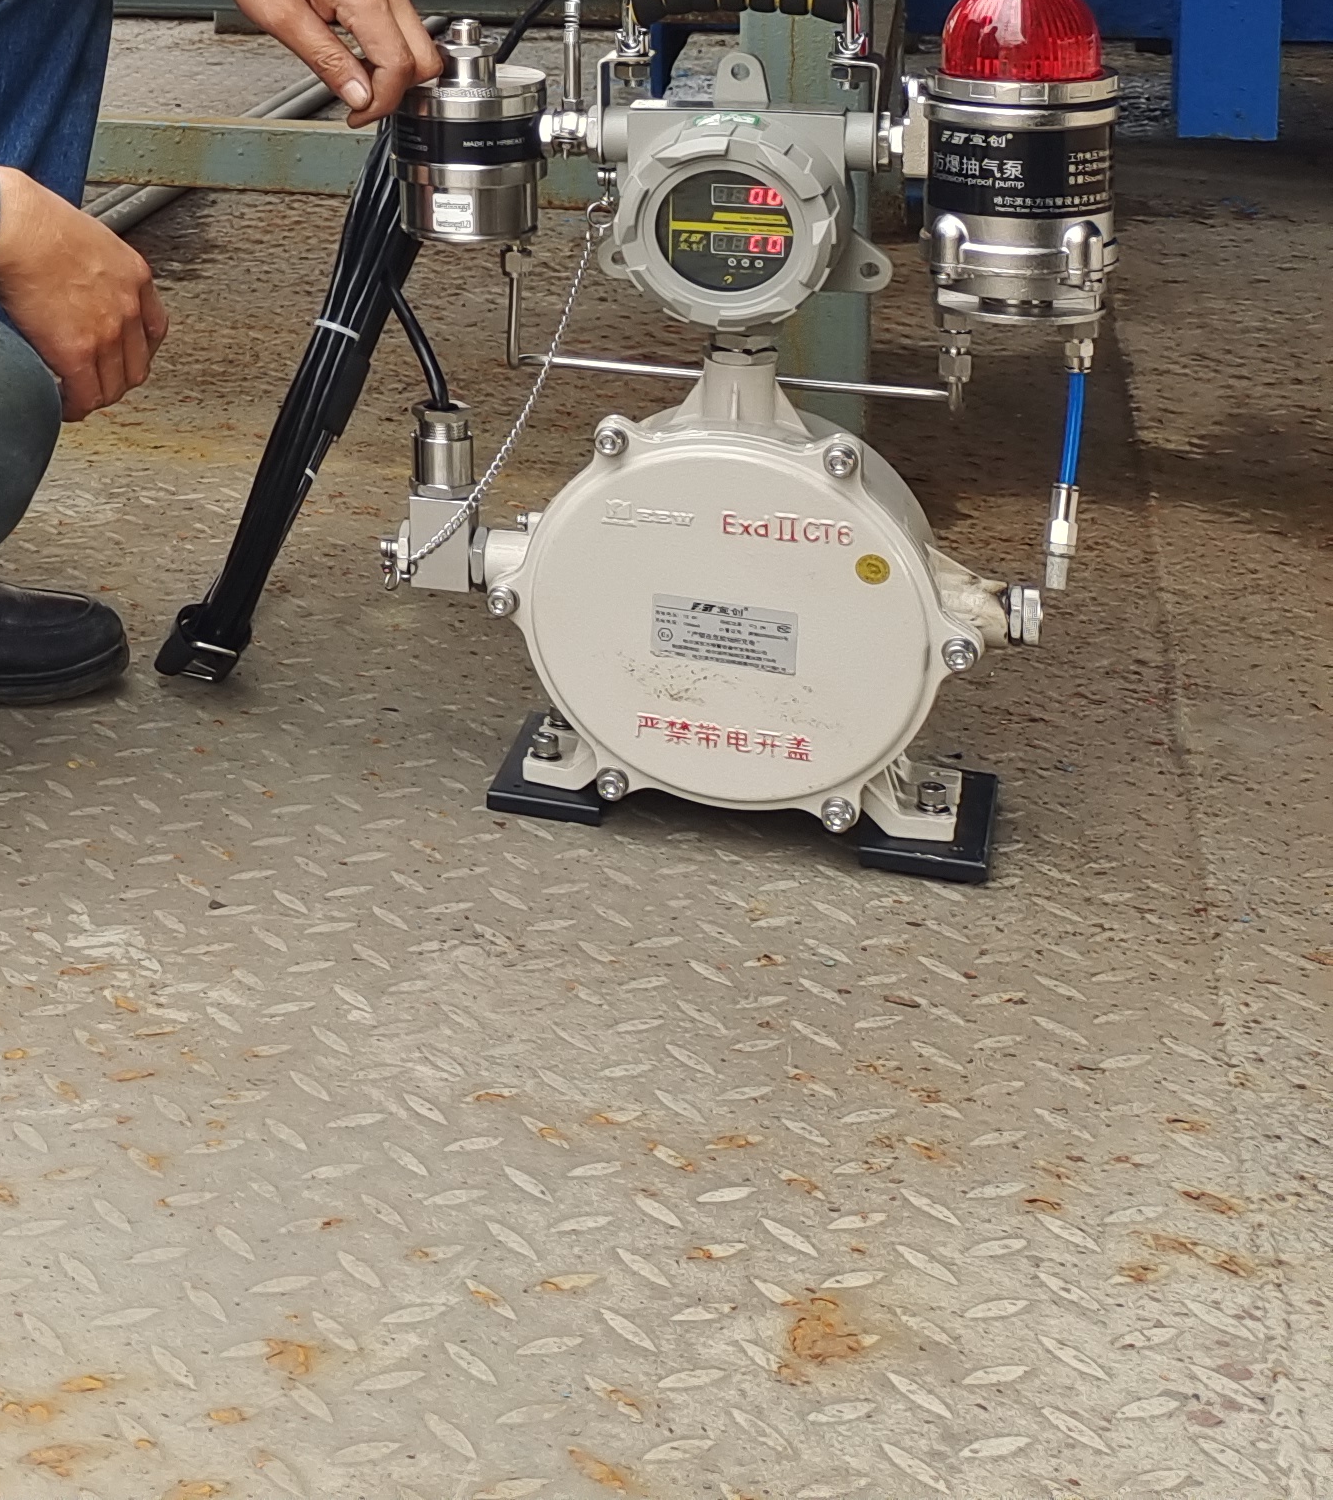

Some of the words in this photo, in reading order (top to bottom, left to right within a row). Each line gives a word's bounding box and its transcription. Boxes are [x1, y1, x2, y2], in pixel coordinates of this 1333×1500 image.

[933, 151, 1023, 179] 防爆抽气泵
[995, 180, 1025, 190] pump
[635, 712, 813, 762] 严禁带电开盖
